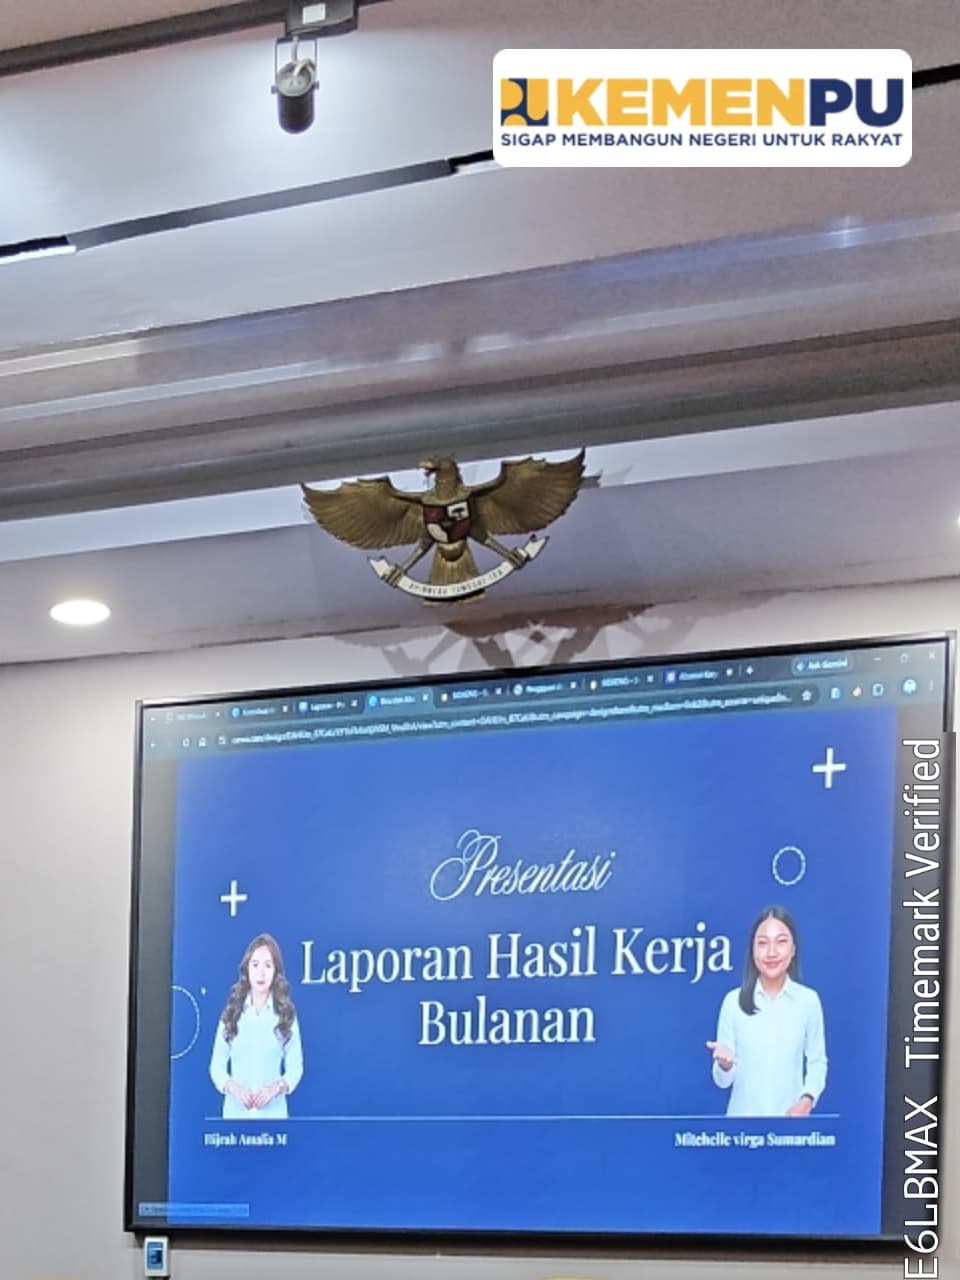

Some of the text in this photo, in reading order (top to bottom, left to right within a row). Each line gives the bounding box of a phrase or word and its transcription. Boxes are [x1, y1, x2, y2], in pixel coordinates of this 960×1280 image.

[430, 829, 616, 901] Presentasi
[301, 922, 734, 993] Laporan Hasil Kerja
[418, 996, 596, 1046] Bulanan
